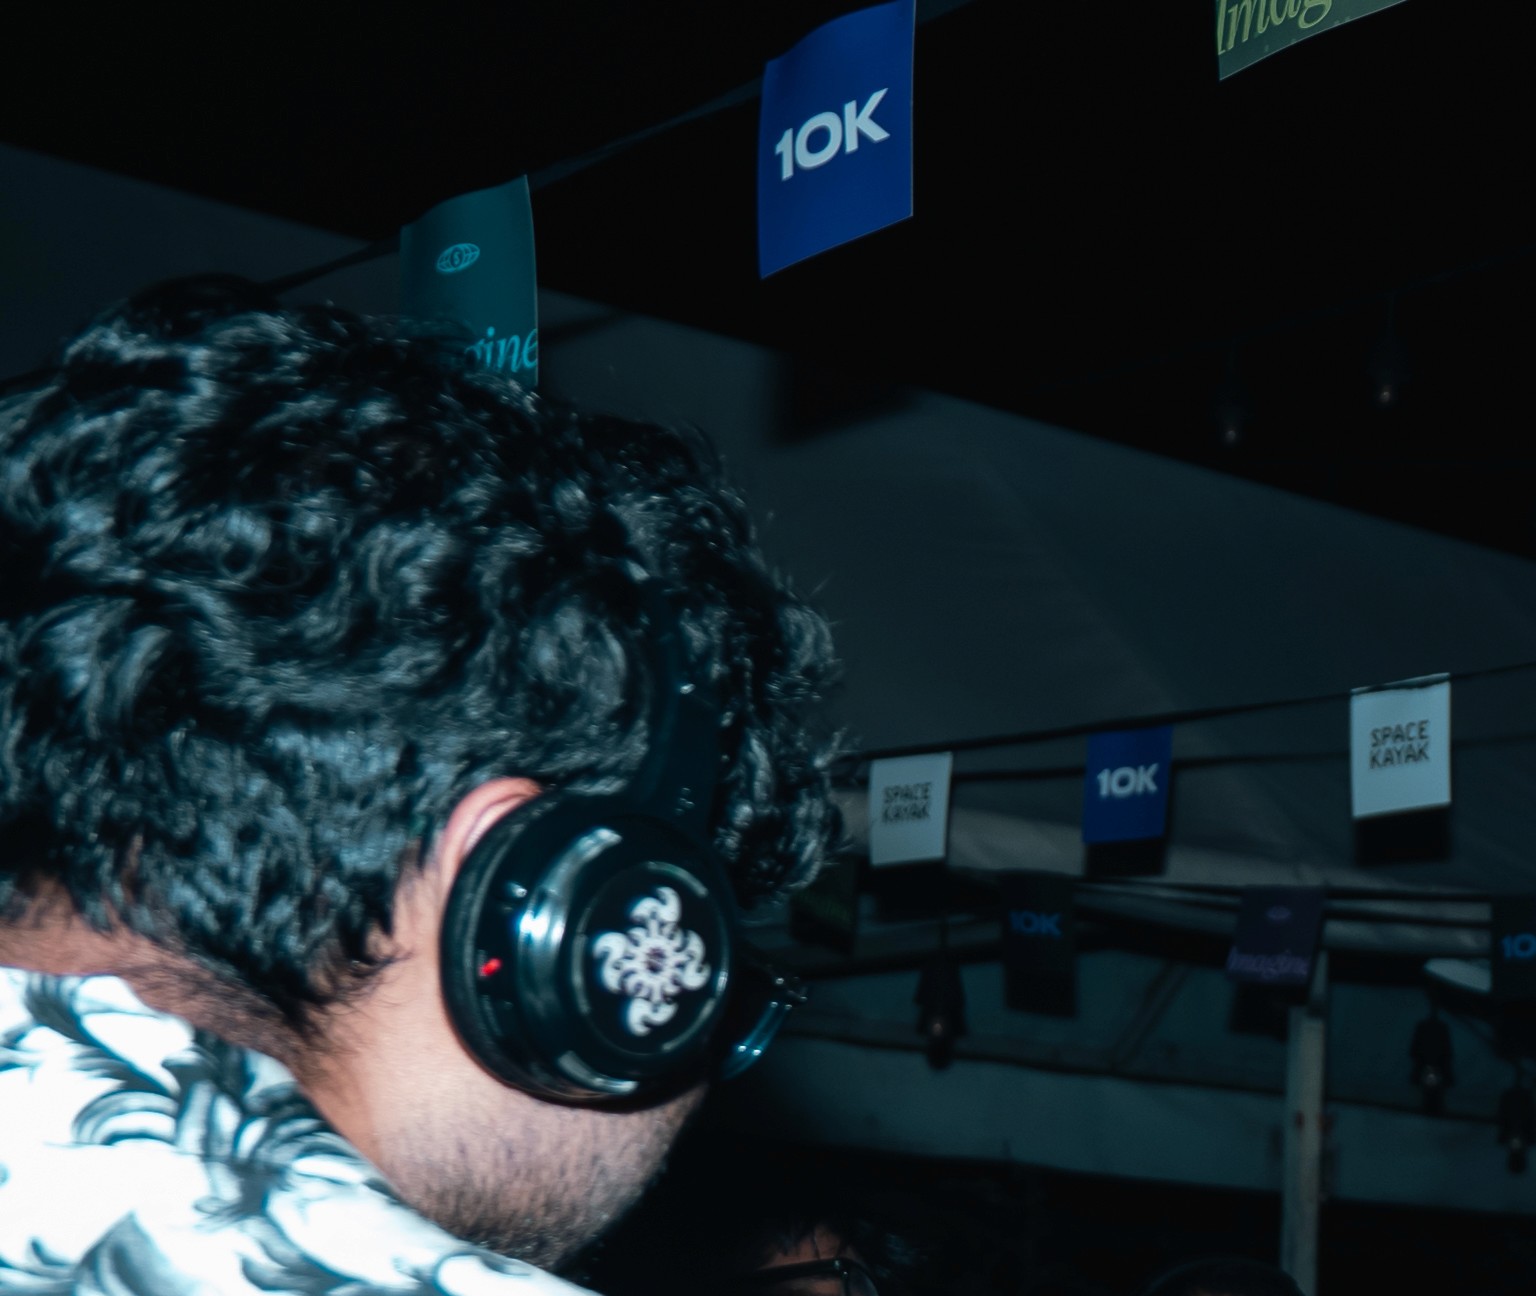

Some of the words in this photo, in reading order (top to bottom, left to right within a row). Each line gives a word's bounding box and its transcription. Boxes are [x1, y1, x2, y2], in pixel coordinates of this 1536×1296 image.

[1217, 0, 1333, 56] Imag
[774, 87, 890, 181] 10K
[1368, 719, 1431, 748] SPACE
[1368, 740, 1431, 770] KAYAK
[1096, 762, 1160, 800] 10K
[1008, 909, 1063, 937] 10K
